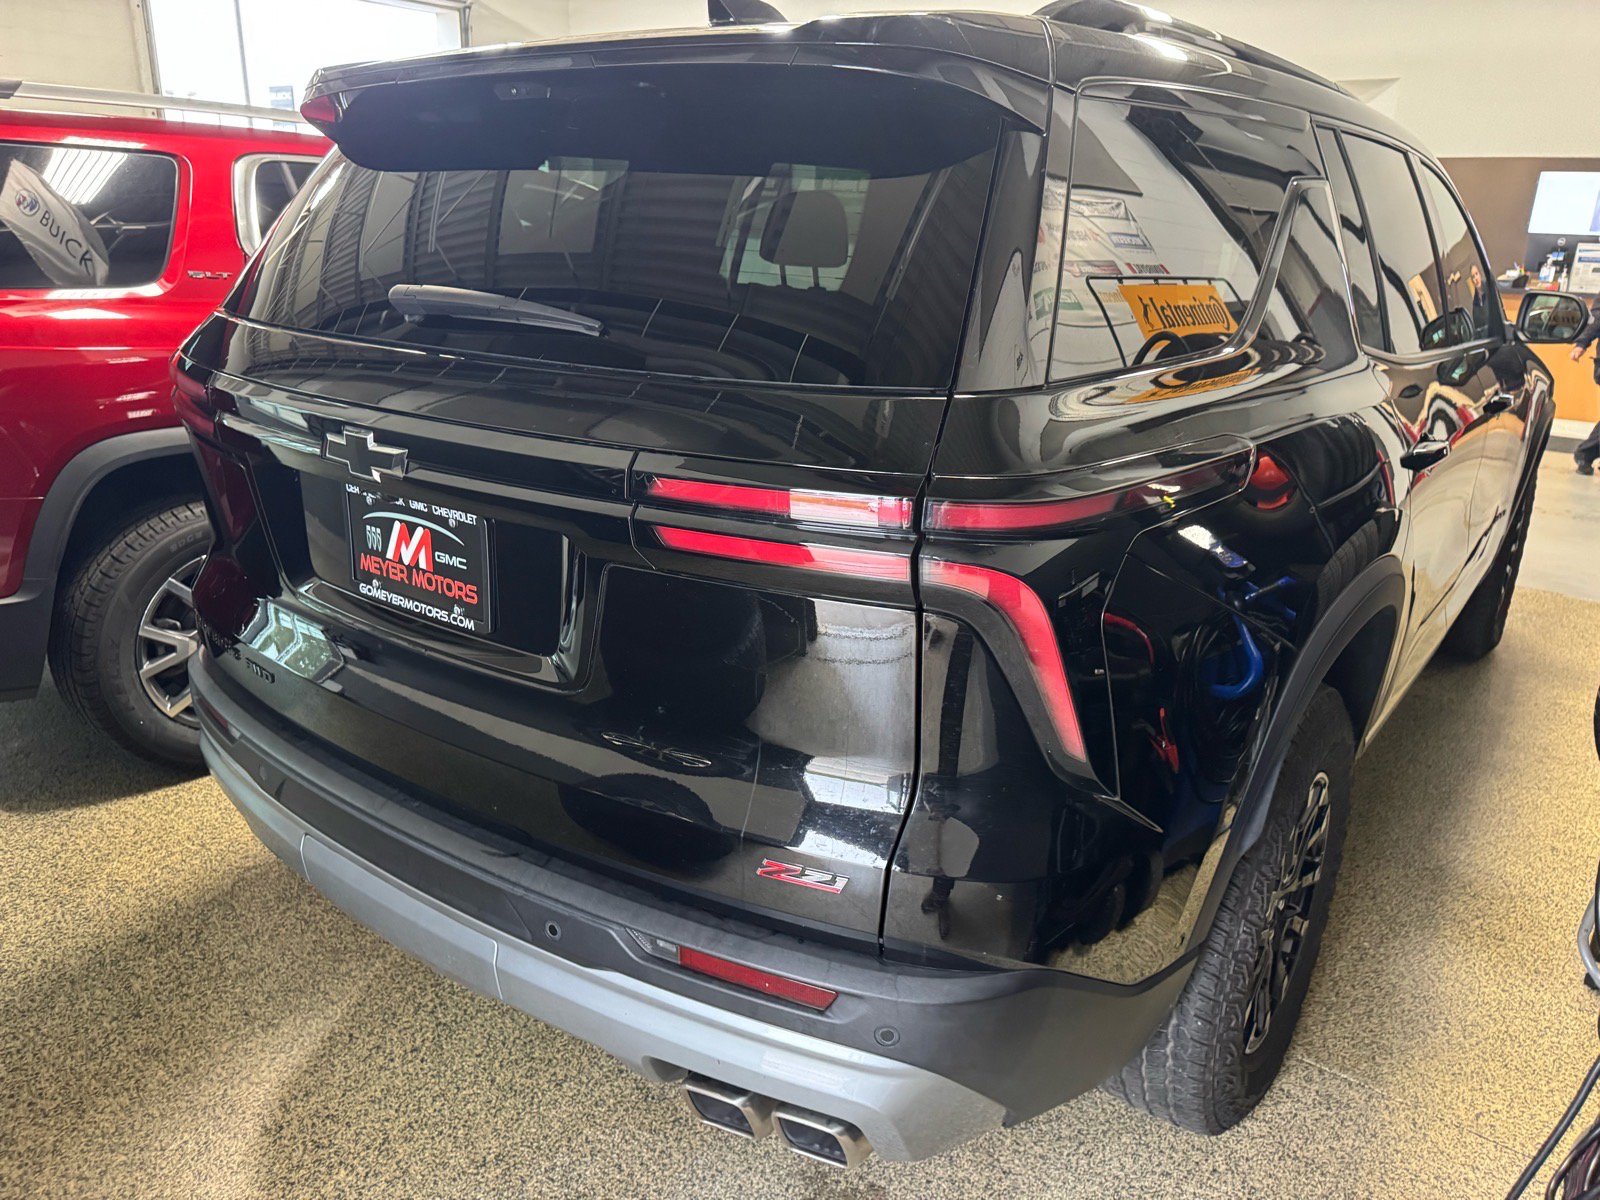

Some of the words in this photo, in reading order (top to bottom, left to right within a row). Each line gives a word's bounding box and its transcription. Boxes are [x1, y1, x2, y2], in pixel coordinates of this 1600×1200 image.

[40, 210, 93, 276] BUICK
[432, 505, 477, 525] CHEVROLET
[360, 553, 408, 584] MEYER
[412, 569, 478, 604] MOTORS
[435, 552, 467, 569] GMC
[359, 583, 475, 631] GOMEYERMOTORS.COM
[756, 857, 849, 893] Z71
